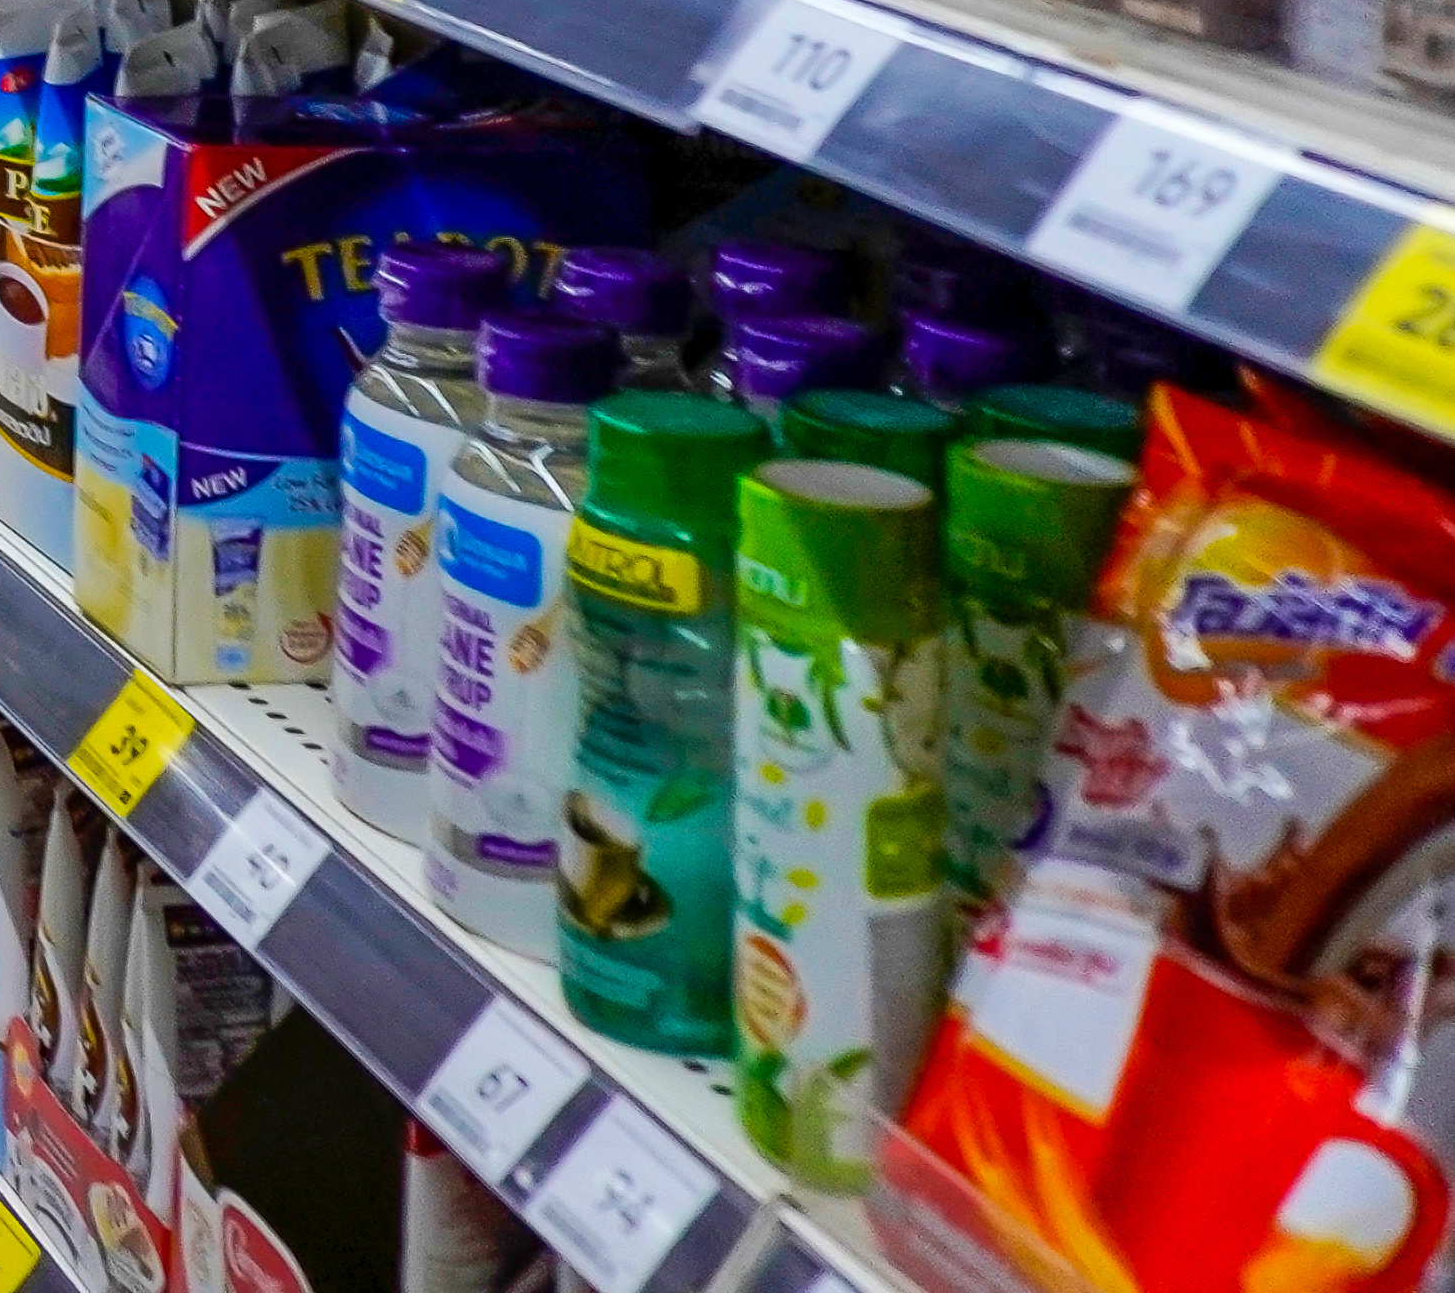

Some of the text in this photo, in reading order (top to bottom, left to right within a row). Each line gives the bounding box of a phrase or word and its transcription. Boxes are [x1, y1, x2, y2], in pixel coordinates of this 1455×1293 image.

[772, 32, 854, 92] 110
[195, 158, 267, 217] NEW
[1135, 149, 1239, 219] 169
[281, 231, 567, 301] TEOT
[192, 467, 247, 498] NEW
[109, 725, 148, 765] 39
